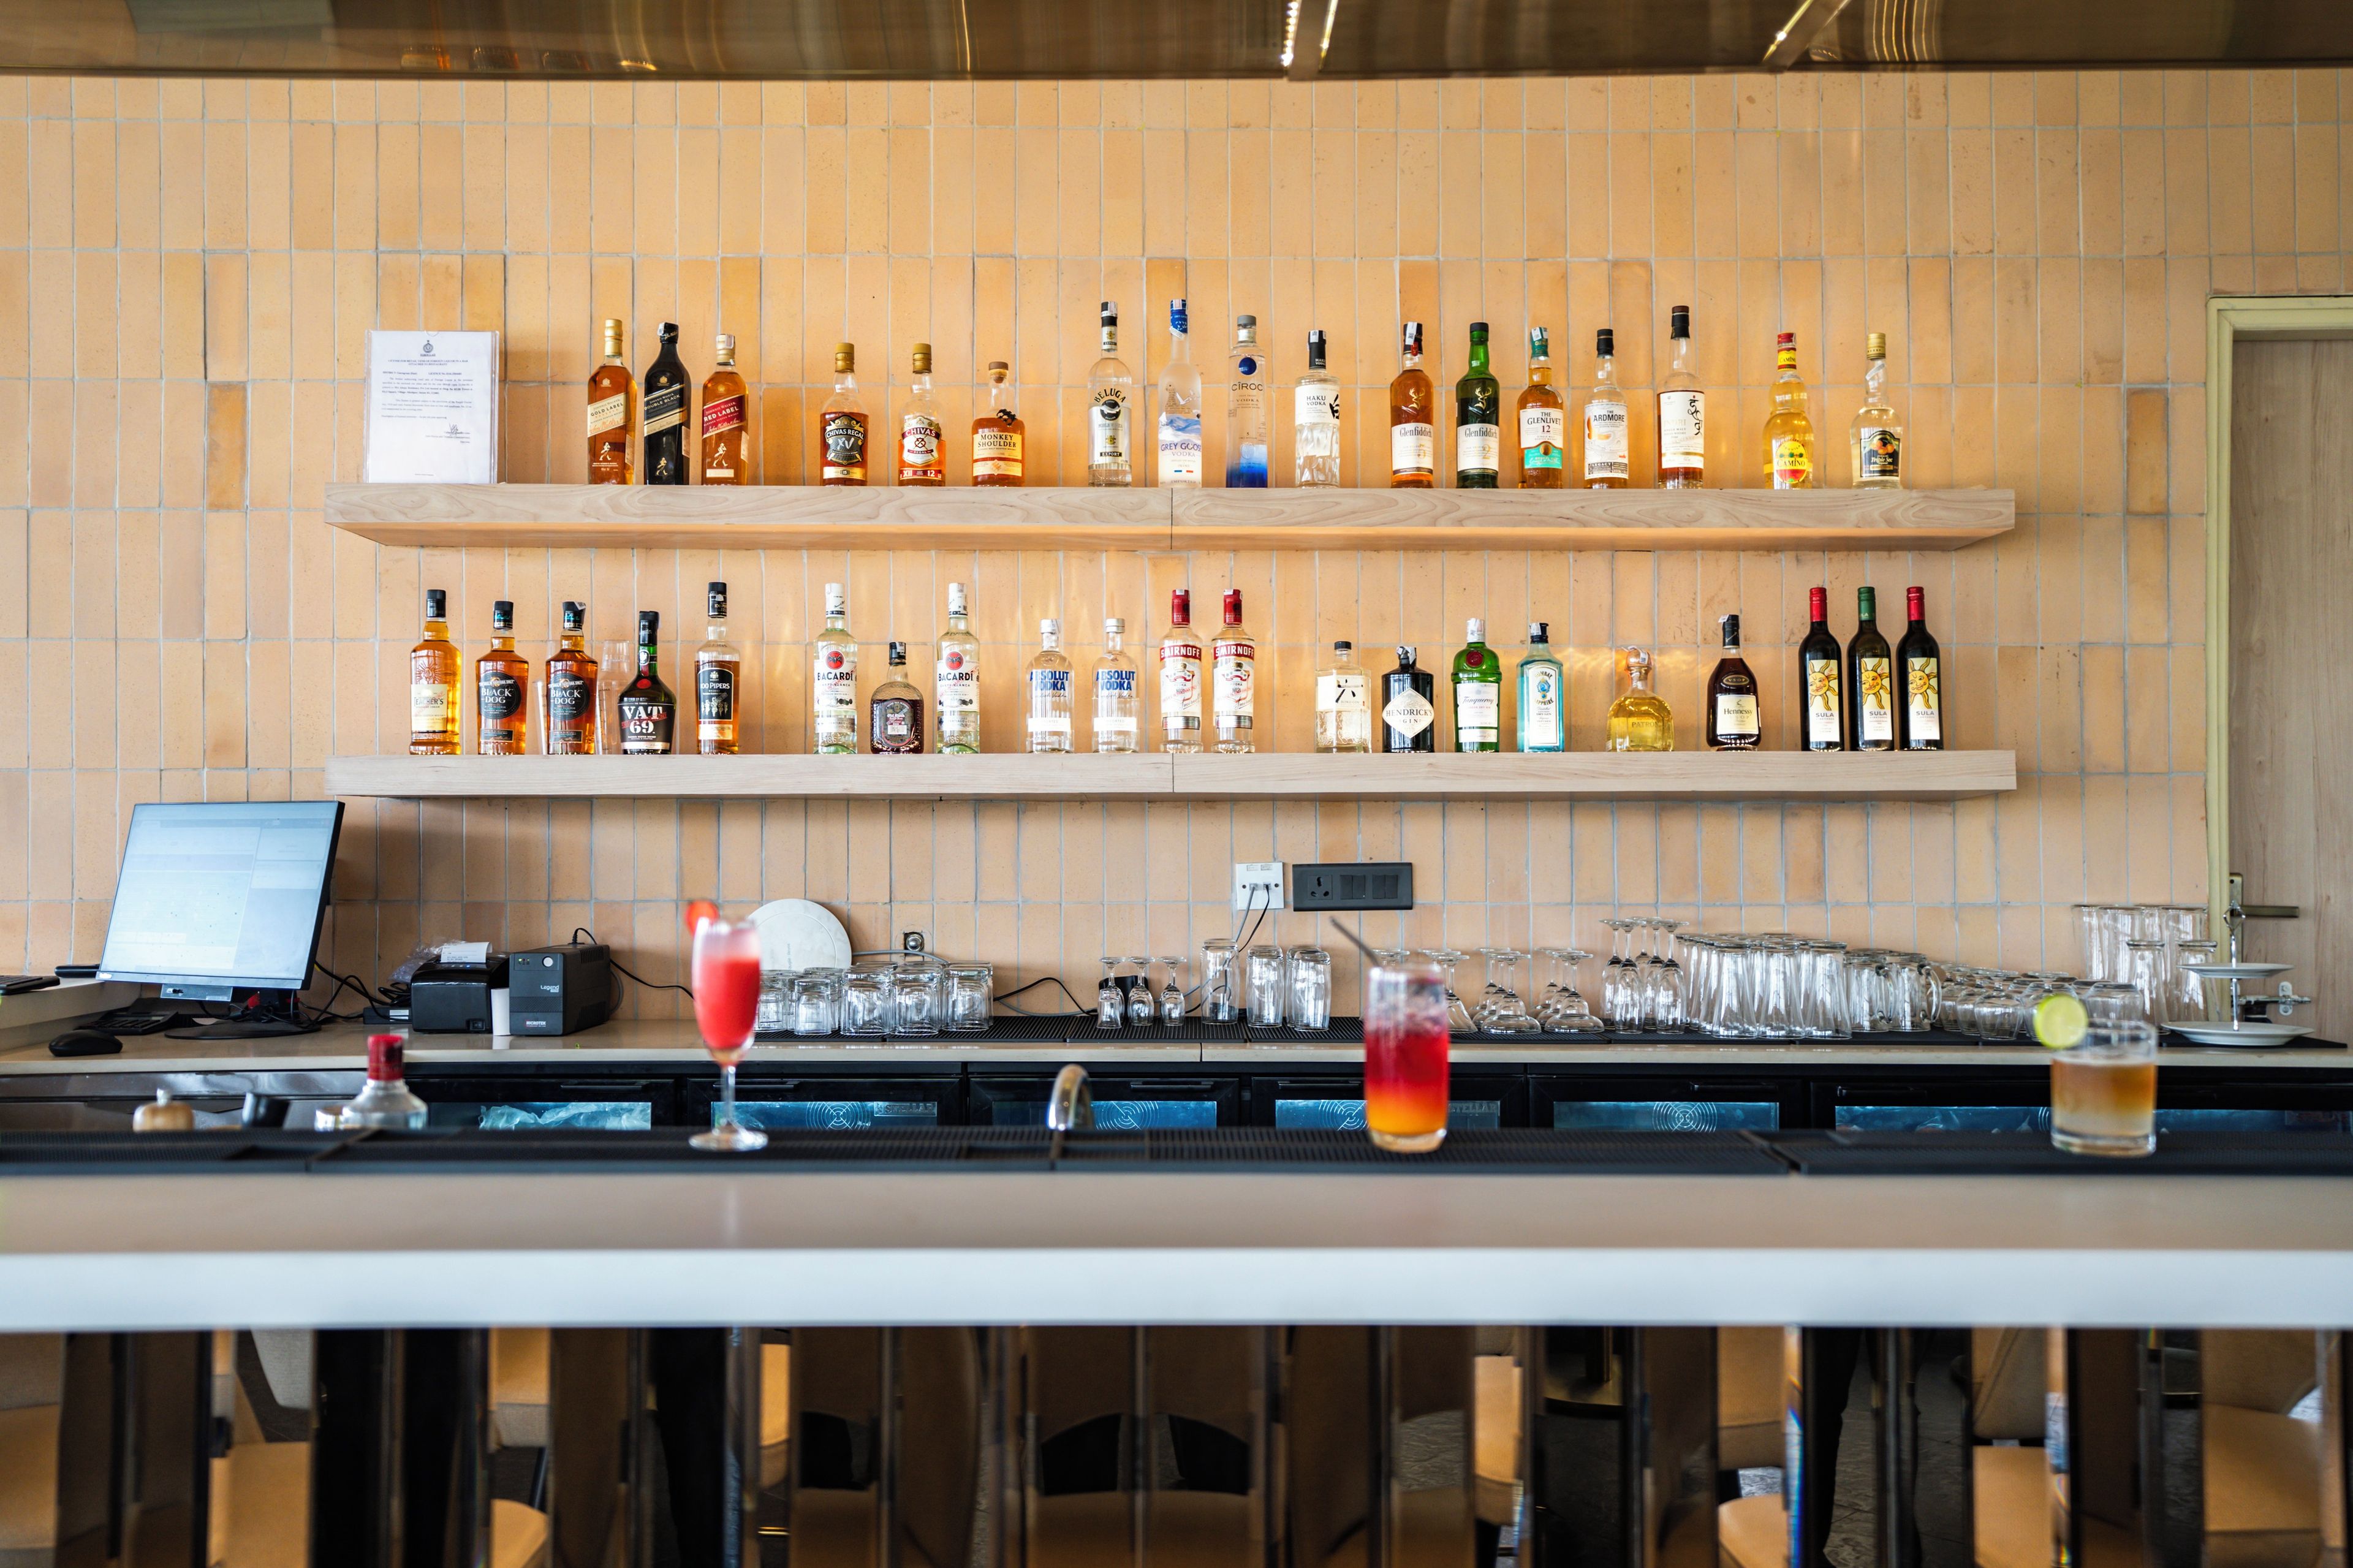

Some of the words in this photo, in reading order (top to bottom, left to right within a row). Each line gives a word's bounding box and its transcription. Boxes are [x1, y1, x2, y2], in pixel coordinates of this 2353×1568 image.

[1232, 382, 1263, 391] CÎROC
[664, 394, 680, 403] BLACK
[1094, 388, 1126, 403] BELUGA
[607, 402, 623, 411] LABEL
[703, 413, 717, 422] RED
[718, 406, 739, 417] LABEL
[826, 429, 847, 438] CHIVAS
[847, 429, 864, 440] REGAL
[906, 428, 936, 436] CHIVAS
[1400, 426, 1432, 437] Glenfiddich
[1464, 427, 1498, 439] Glenfiddich
[837, 437, 855, 450] XV
[1161, 442, 1178, 452] GREY
[1180, 442, 1201, 452] GOOS
[1161, 646, 1200, 657] SMIRNOFF
[1216, 646, 1254, 657] SMIRNOFF
[939, 671, 973, 681] BACARDÍ
[1030, 671, 1069, 681] ABSOLUT
[1096, 670, 1135, 681] ABSOLUT
[1101, 681, 1132, 691] VODKA
[482, 688, 512, 697] BLACK
[1463, 696, 1494, 705] Tanqueray
[623, 706, 662, 719] VAT
